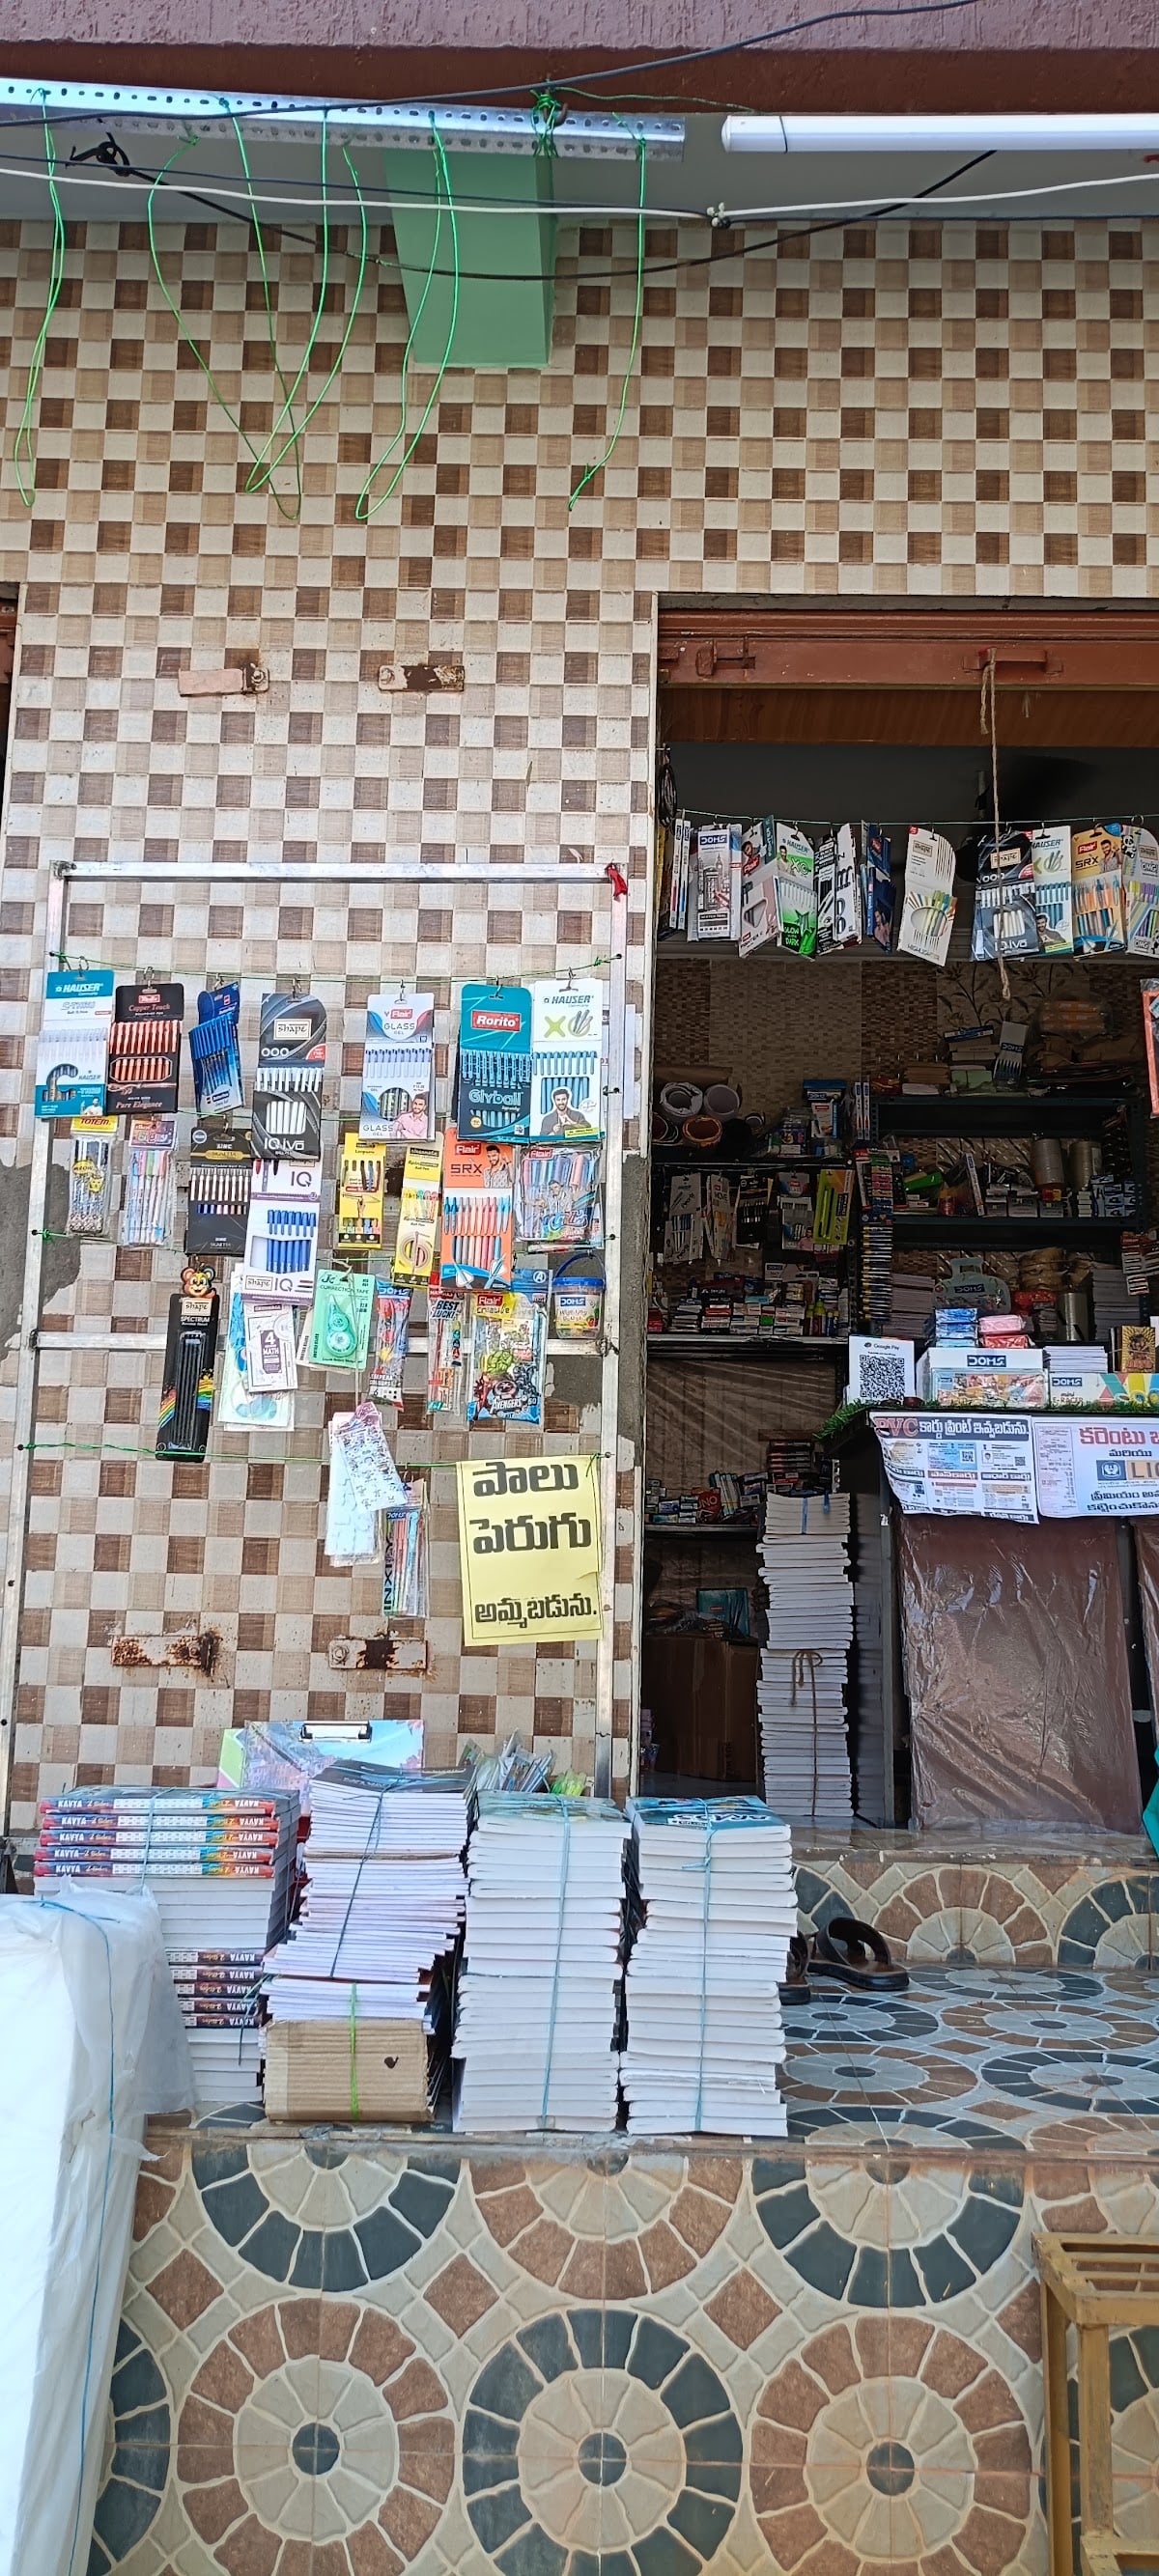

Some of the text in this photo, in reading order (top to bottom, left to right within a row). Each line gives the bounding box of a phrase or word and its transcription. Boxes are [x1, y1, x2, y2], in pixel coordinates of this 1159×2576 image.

[700, 835, 727, 845] DOMS
[1075, 855, 1099, 869] SRX
[63, 982, 102, 994] HAUSER
[551, 994, 591, 1004] HAUSER
[127, 1004, 151, 1013] Copper
[391, 1009, 412, 1019] Flair
[476, 1014, 517, 1027] Rorito
[277, 1023, 308, 1035] shape
[468, 1088, 522, 1106] Glyball
[115, 1100, 163, 1109] Pure Elegance
[455, 1144, 481, 1156] Flair
[450, 1163, 482, 1175] SRX
[291, 1171, 313, 1188] IQ
[274, 1276, 294, 1293] IQ
[437, 1300, 460, 1310] BEST
[478, 1295, 503, 1305] Flair
[560, 1297, 586, 1306] DOMS
[264, 1331, 276, 1345] 4
[968, 1356, 1006, 1367] DOMS
[1052, 1378, 1082, 1386] DOMS
[491, 1398, 523, 1414] AVENGERS
[874, 1417, 919, 1438] PVC
[919, 1420, 945, 1439] కార్డు
[1079, 1426, 1146, 1445] కరెంటు
[472, 1461, 580, 1498] పాలు
[698, 1495, 719, 1507] UNO
[469, 1512, 592, 1554] పెరుగు
[58, 1800, 83, 1808] KAVYA
[62, 1817, 87, 1826] KAVYA
[240, 1817, 265, 1826] KAVYA
[60, 1833, 84, 1841] KAVYA
[239, 1833, 263, 1841] KAVYA
[54, 1849, 79, 1858] KAVYA
[56, 1864, 80, 1873] KAVYA
[229, 1971, 255, 1979] KAVYA
